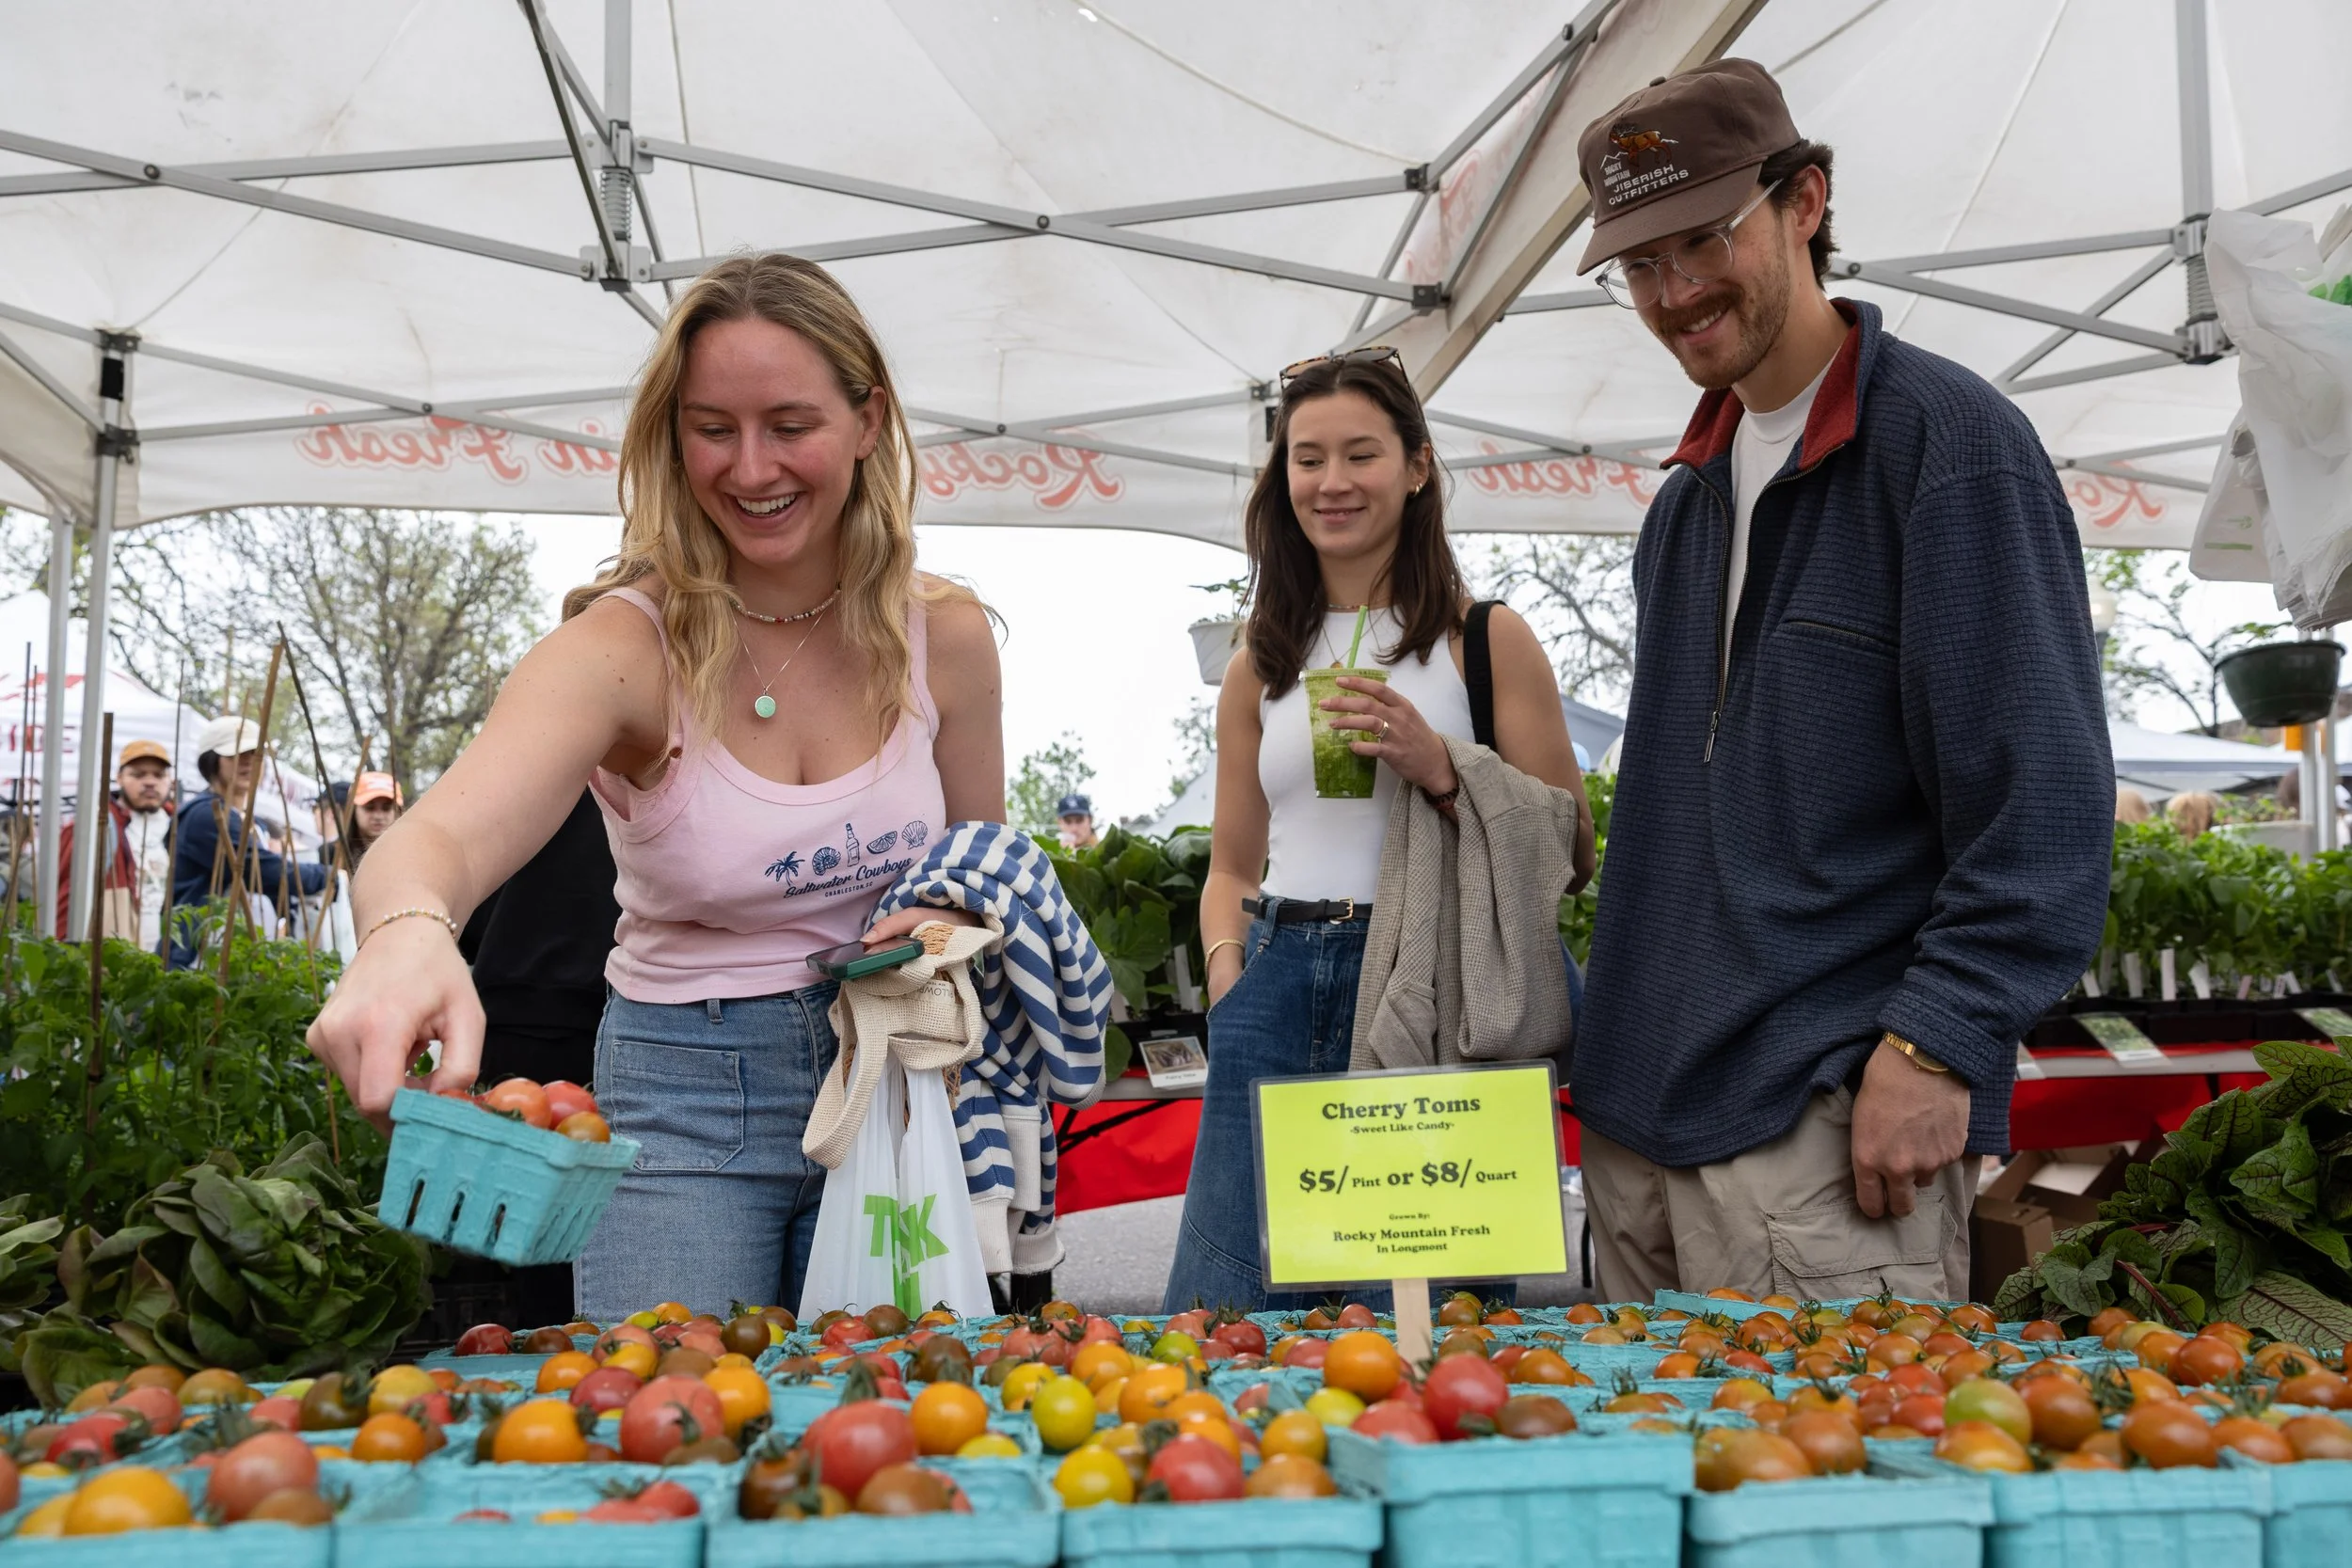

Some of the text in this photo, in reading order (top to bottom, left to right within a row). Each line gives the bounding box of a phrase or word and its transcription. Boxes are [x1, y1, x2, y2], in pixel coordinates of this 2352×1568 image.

[1608, 169, 1690, 205] OUTFITTERS
[1613, 163, 1675, 193] JIBERISH
[783, 858, 914, 899] Saltwater Cowboys
[1321, 1097, 1481, 1120] Cherry Toms
[1390, 1123, 1414, 1132] Like
[1298, 1158, 1518, 1195] $5/ Pint or $8/ Quart
[1333, 1225, 1490, 1243] Rocky Mountain Fresh
[1376, 1243, 1448, 1254] In Longmont
